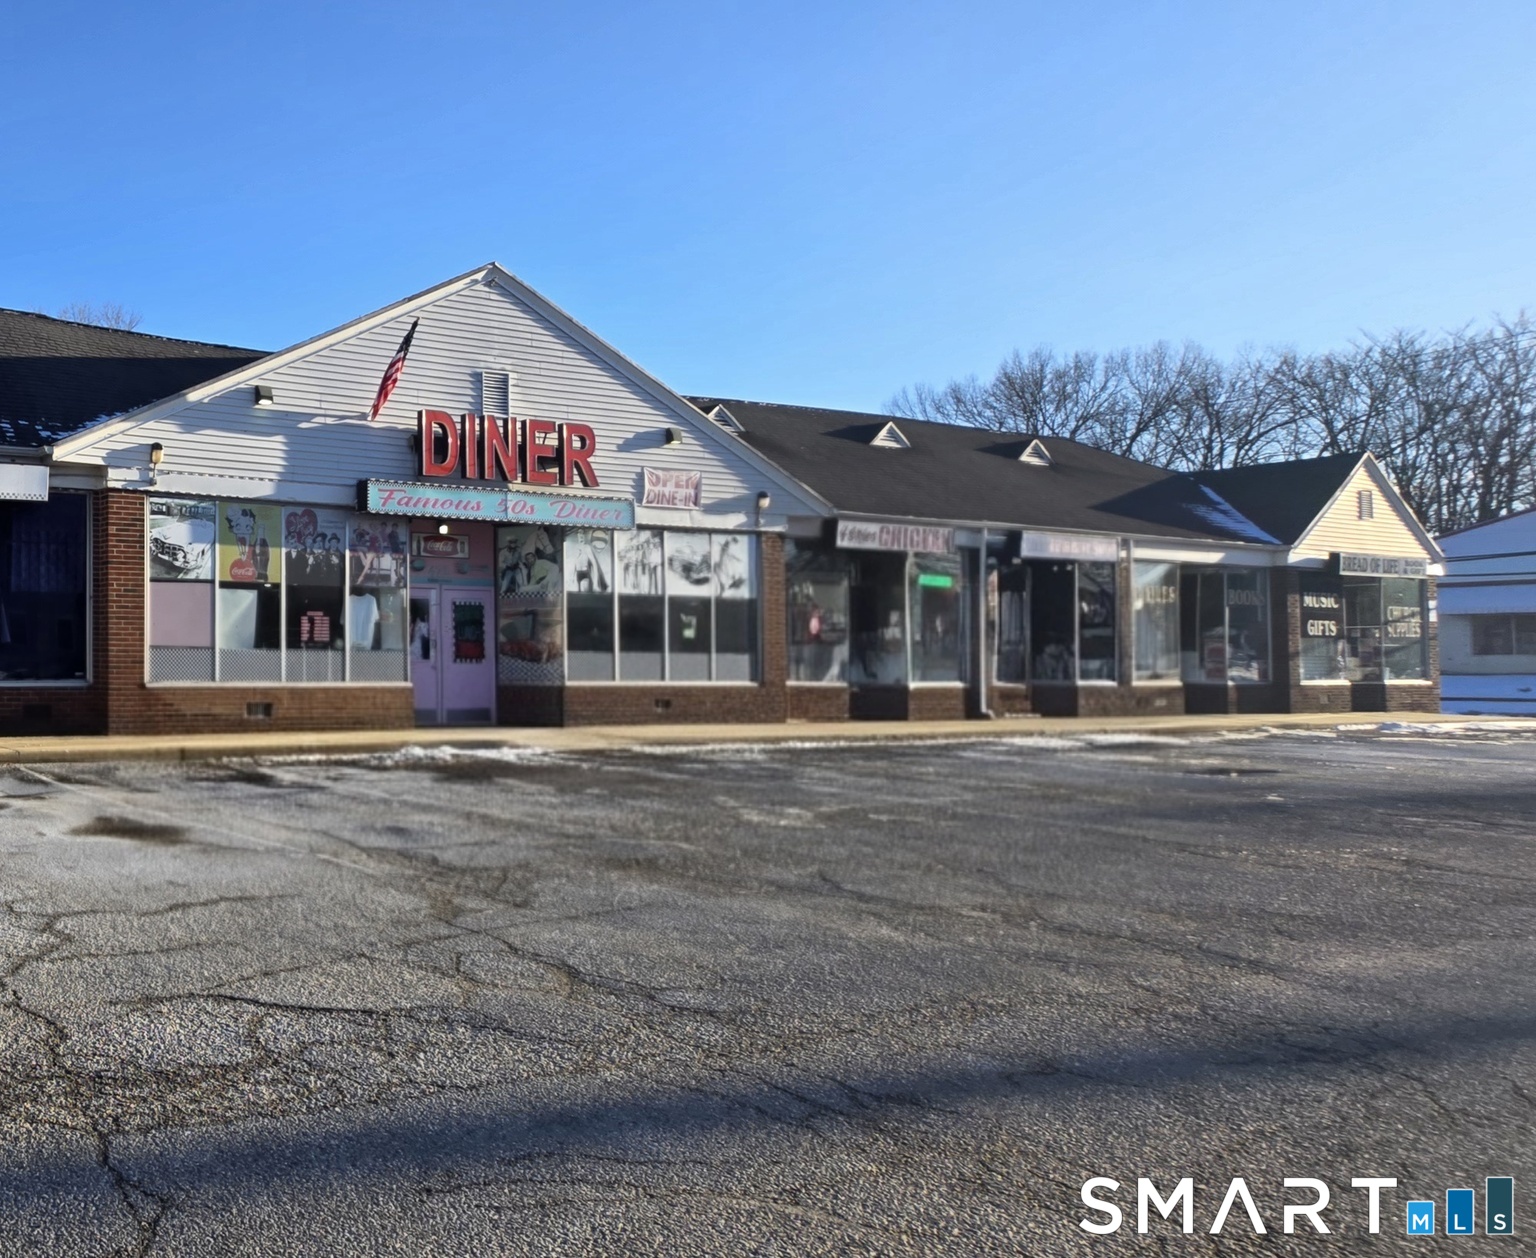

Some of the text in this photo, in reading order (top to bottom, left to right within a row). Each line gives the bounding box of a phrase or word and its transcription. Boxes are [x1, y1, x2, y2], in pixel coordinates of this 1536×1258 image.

[417, 408, 600, 488] DINER
[376, 486, 624, 522] Famous 50s Diner
[1303, 593, 1340, 609] MUSIC
[1307, 619, 1337, 637] GIFTS
